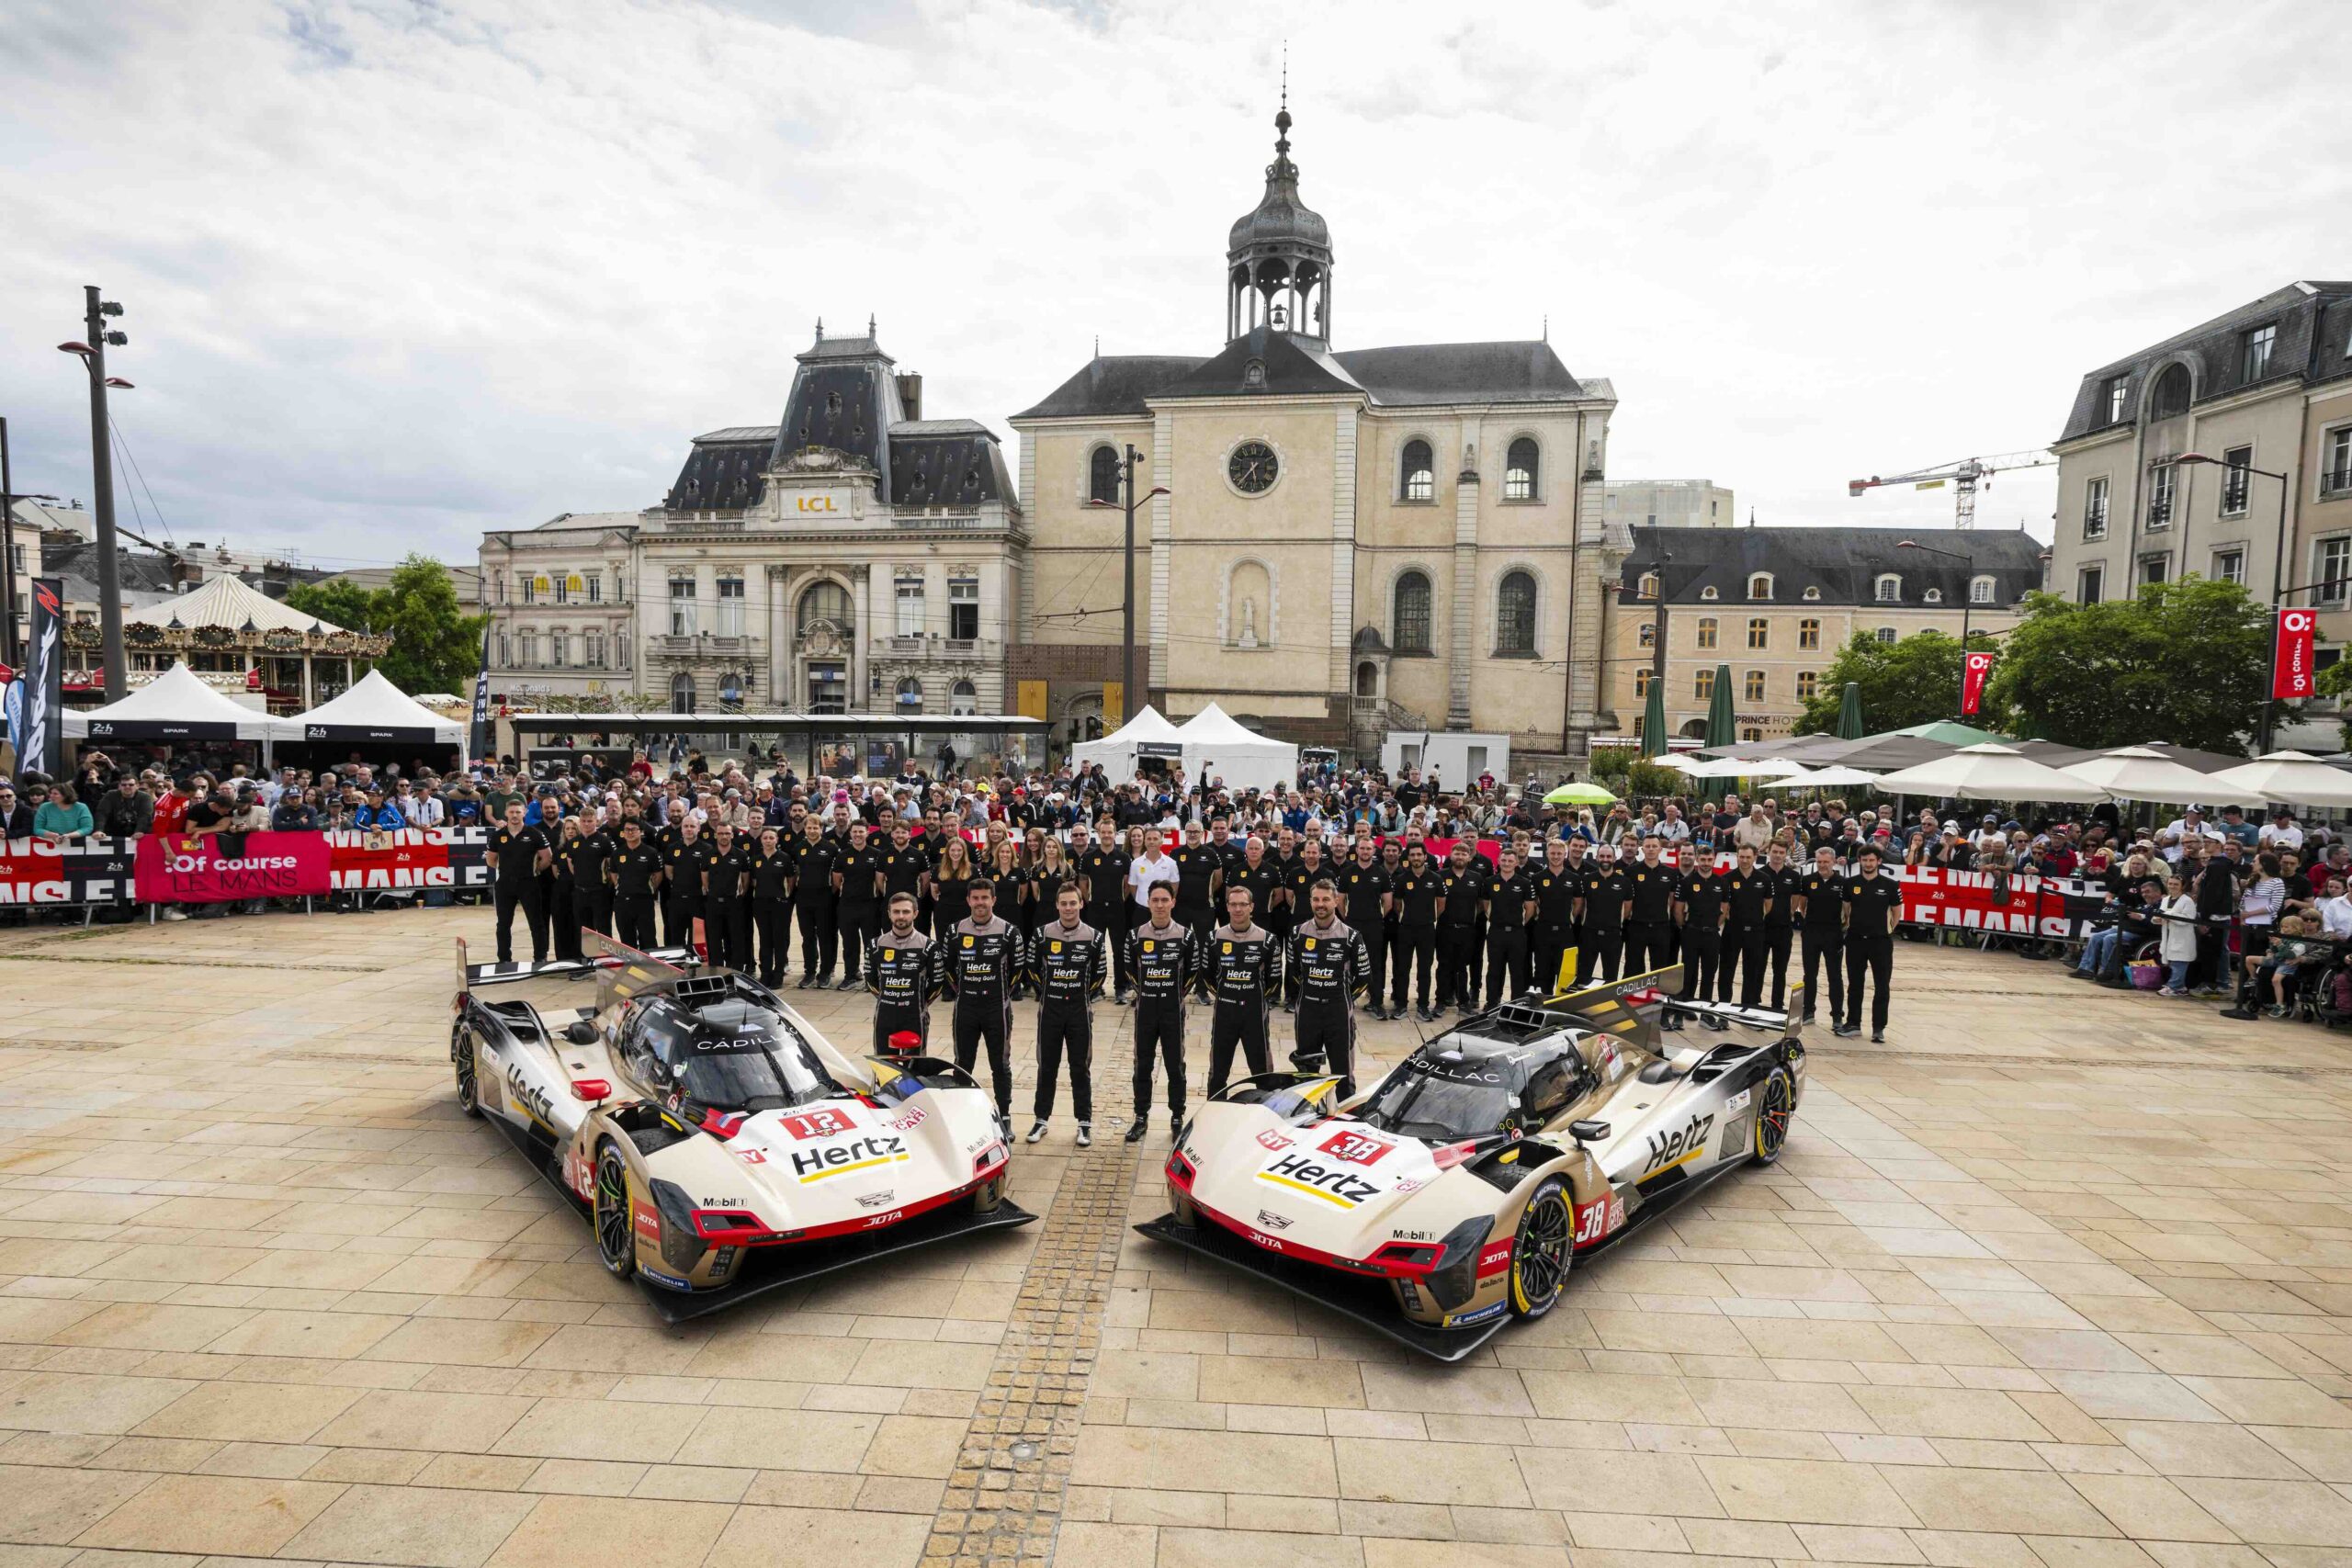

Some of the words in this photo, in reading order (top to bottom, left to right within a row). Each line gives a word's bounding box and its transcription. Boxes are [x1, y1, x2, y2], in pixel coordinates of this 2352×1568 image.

[797, 497, 838, 512] LCL
[1735, 716, 1770, 725] PRINCE
[1772, 716, 1797, 725] HOT
[212, 855, 298, 872] course
[173, 874, 207, 893] LE
[220, 870, 299, 890] MANS
[1147, 967, 1171, 976] Hertz
[1309, 967, 1334, 976] Hertz
[1616, 976, 1658, 996] CADILLAC
[1407, 1054, 1501, 1083] CADILLAC
[507, 1063, 555, 1128] Hertz
[794, 1112, 844, 1137] 12
[1329, 1134, 1383, 1162] 38
[1644, 1112, 1715, 1174] Hertz
[792, 1135, 907, 1175] Hertz
[575, 1158, 596, 1200] 12
[1267, 1154, 1382, 1203] Hertz
[1536, 1182, 1561, 1200] MICHELIN
[703, 1198, 736, 1207] Mobil
[636, 1213, 658, 1228] JOTA
[863, 1210, 902, 1227] JOTA
[1575, 1200, 1606, 1243] 38
[1248, 1231, 1283, 1250] JOTA
[1393, 1230, 1425, 1241] Mobil
[1481, 1250, 1509, 1266] JOTA
[649, 1271, 685, 1288] MICHELIN
[1463, 1305, 1501, 1323] MICHELIN
